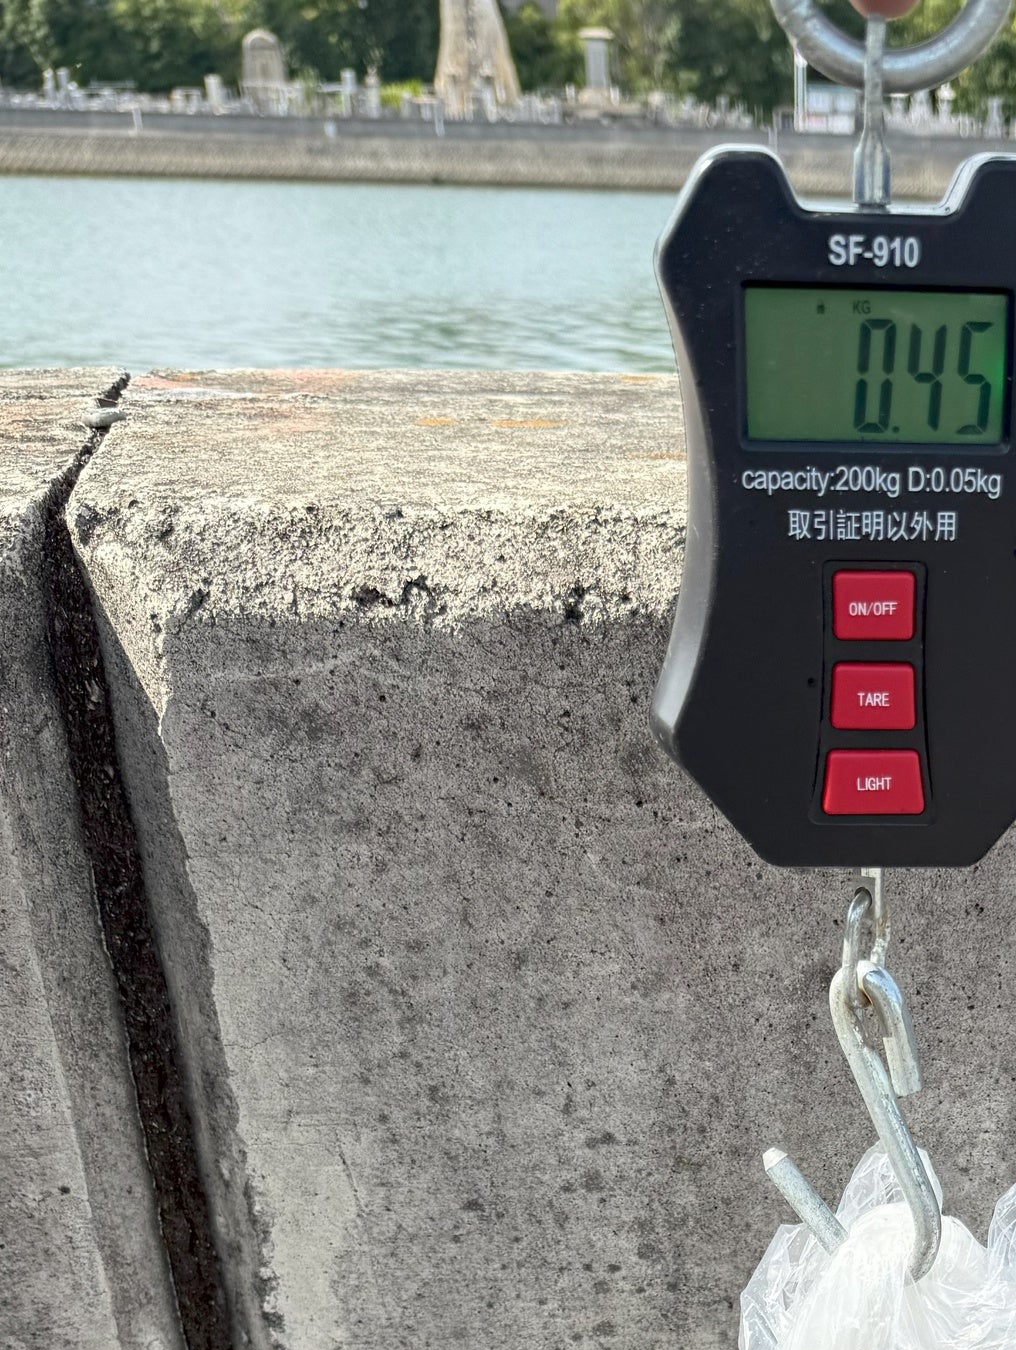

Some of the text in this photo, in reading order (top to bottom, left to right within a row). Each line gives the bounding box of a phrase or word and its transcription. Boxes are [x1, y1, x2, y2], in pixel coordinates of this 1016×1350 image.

[828, 234, 921, 268] SF-910
[853, 301, 872, 315] KG
[853, 318, 994, 435] 0.45
[741, 466, 1002, 499] capacity:200kg D:0.05kg
[787, 509, 957, 542] 取引証明以外用
[848, 601, 898, 617] ON/OFF
[857, 691, 891, 708] TARE
[856, 776, 892, 792] LIGHT
